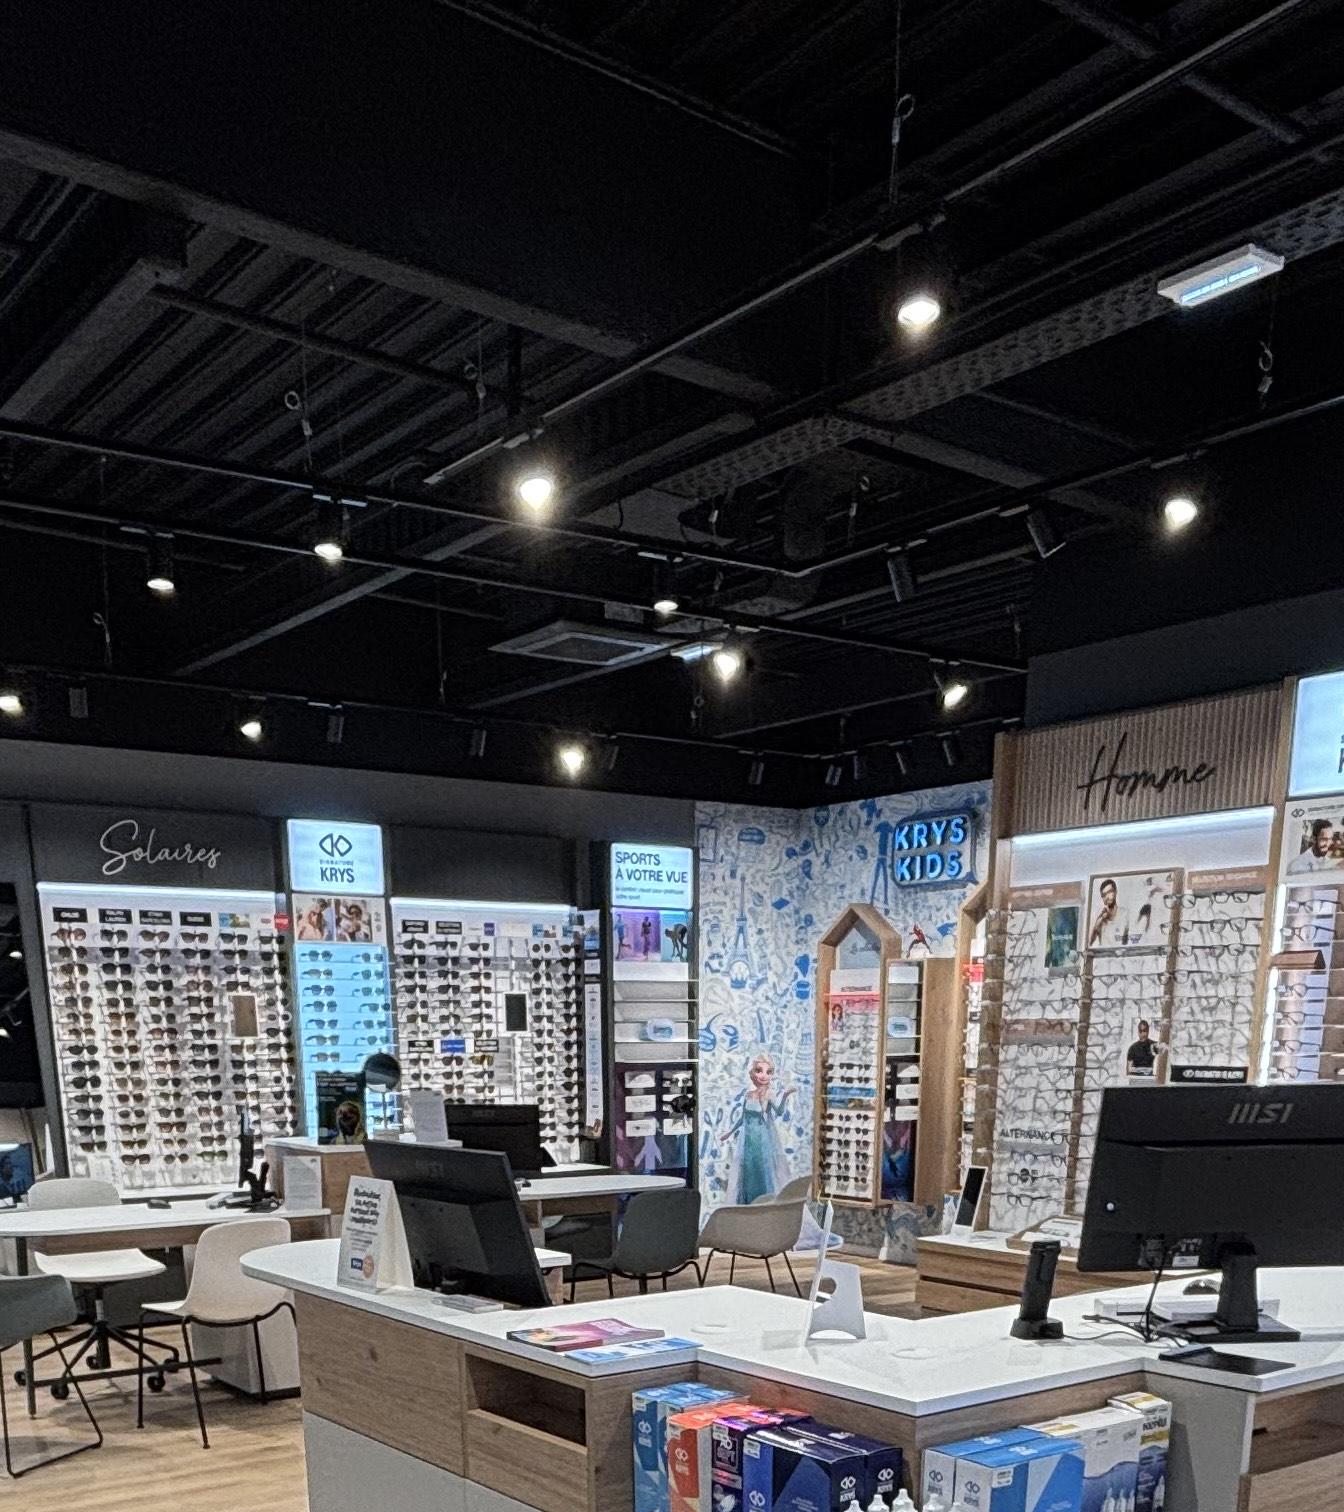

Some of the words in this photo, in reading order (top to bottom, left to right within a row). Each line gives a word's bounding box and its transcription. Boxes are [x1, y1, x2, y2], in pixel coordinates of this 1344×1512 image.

[1077, 731, 1217, 812] Homme
[895, 817, 965, 850] KRYS
[99, 819, 222, 876] Solaires
[616, 852, 661, 866] SPORTS
[320, 867, 355, 883] KRYS
[626, 868, 663, 882] VOTRE
[666, 871, 688, 883] VUE
[896, 850, 960, 881] KIDS
[1228, 1103, 1294, 1124] MSI
